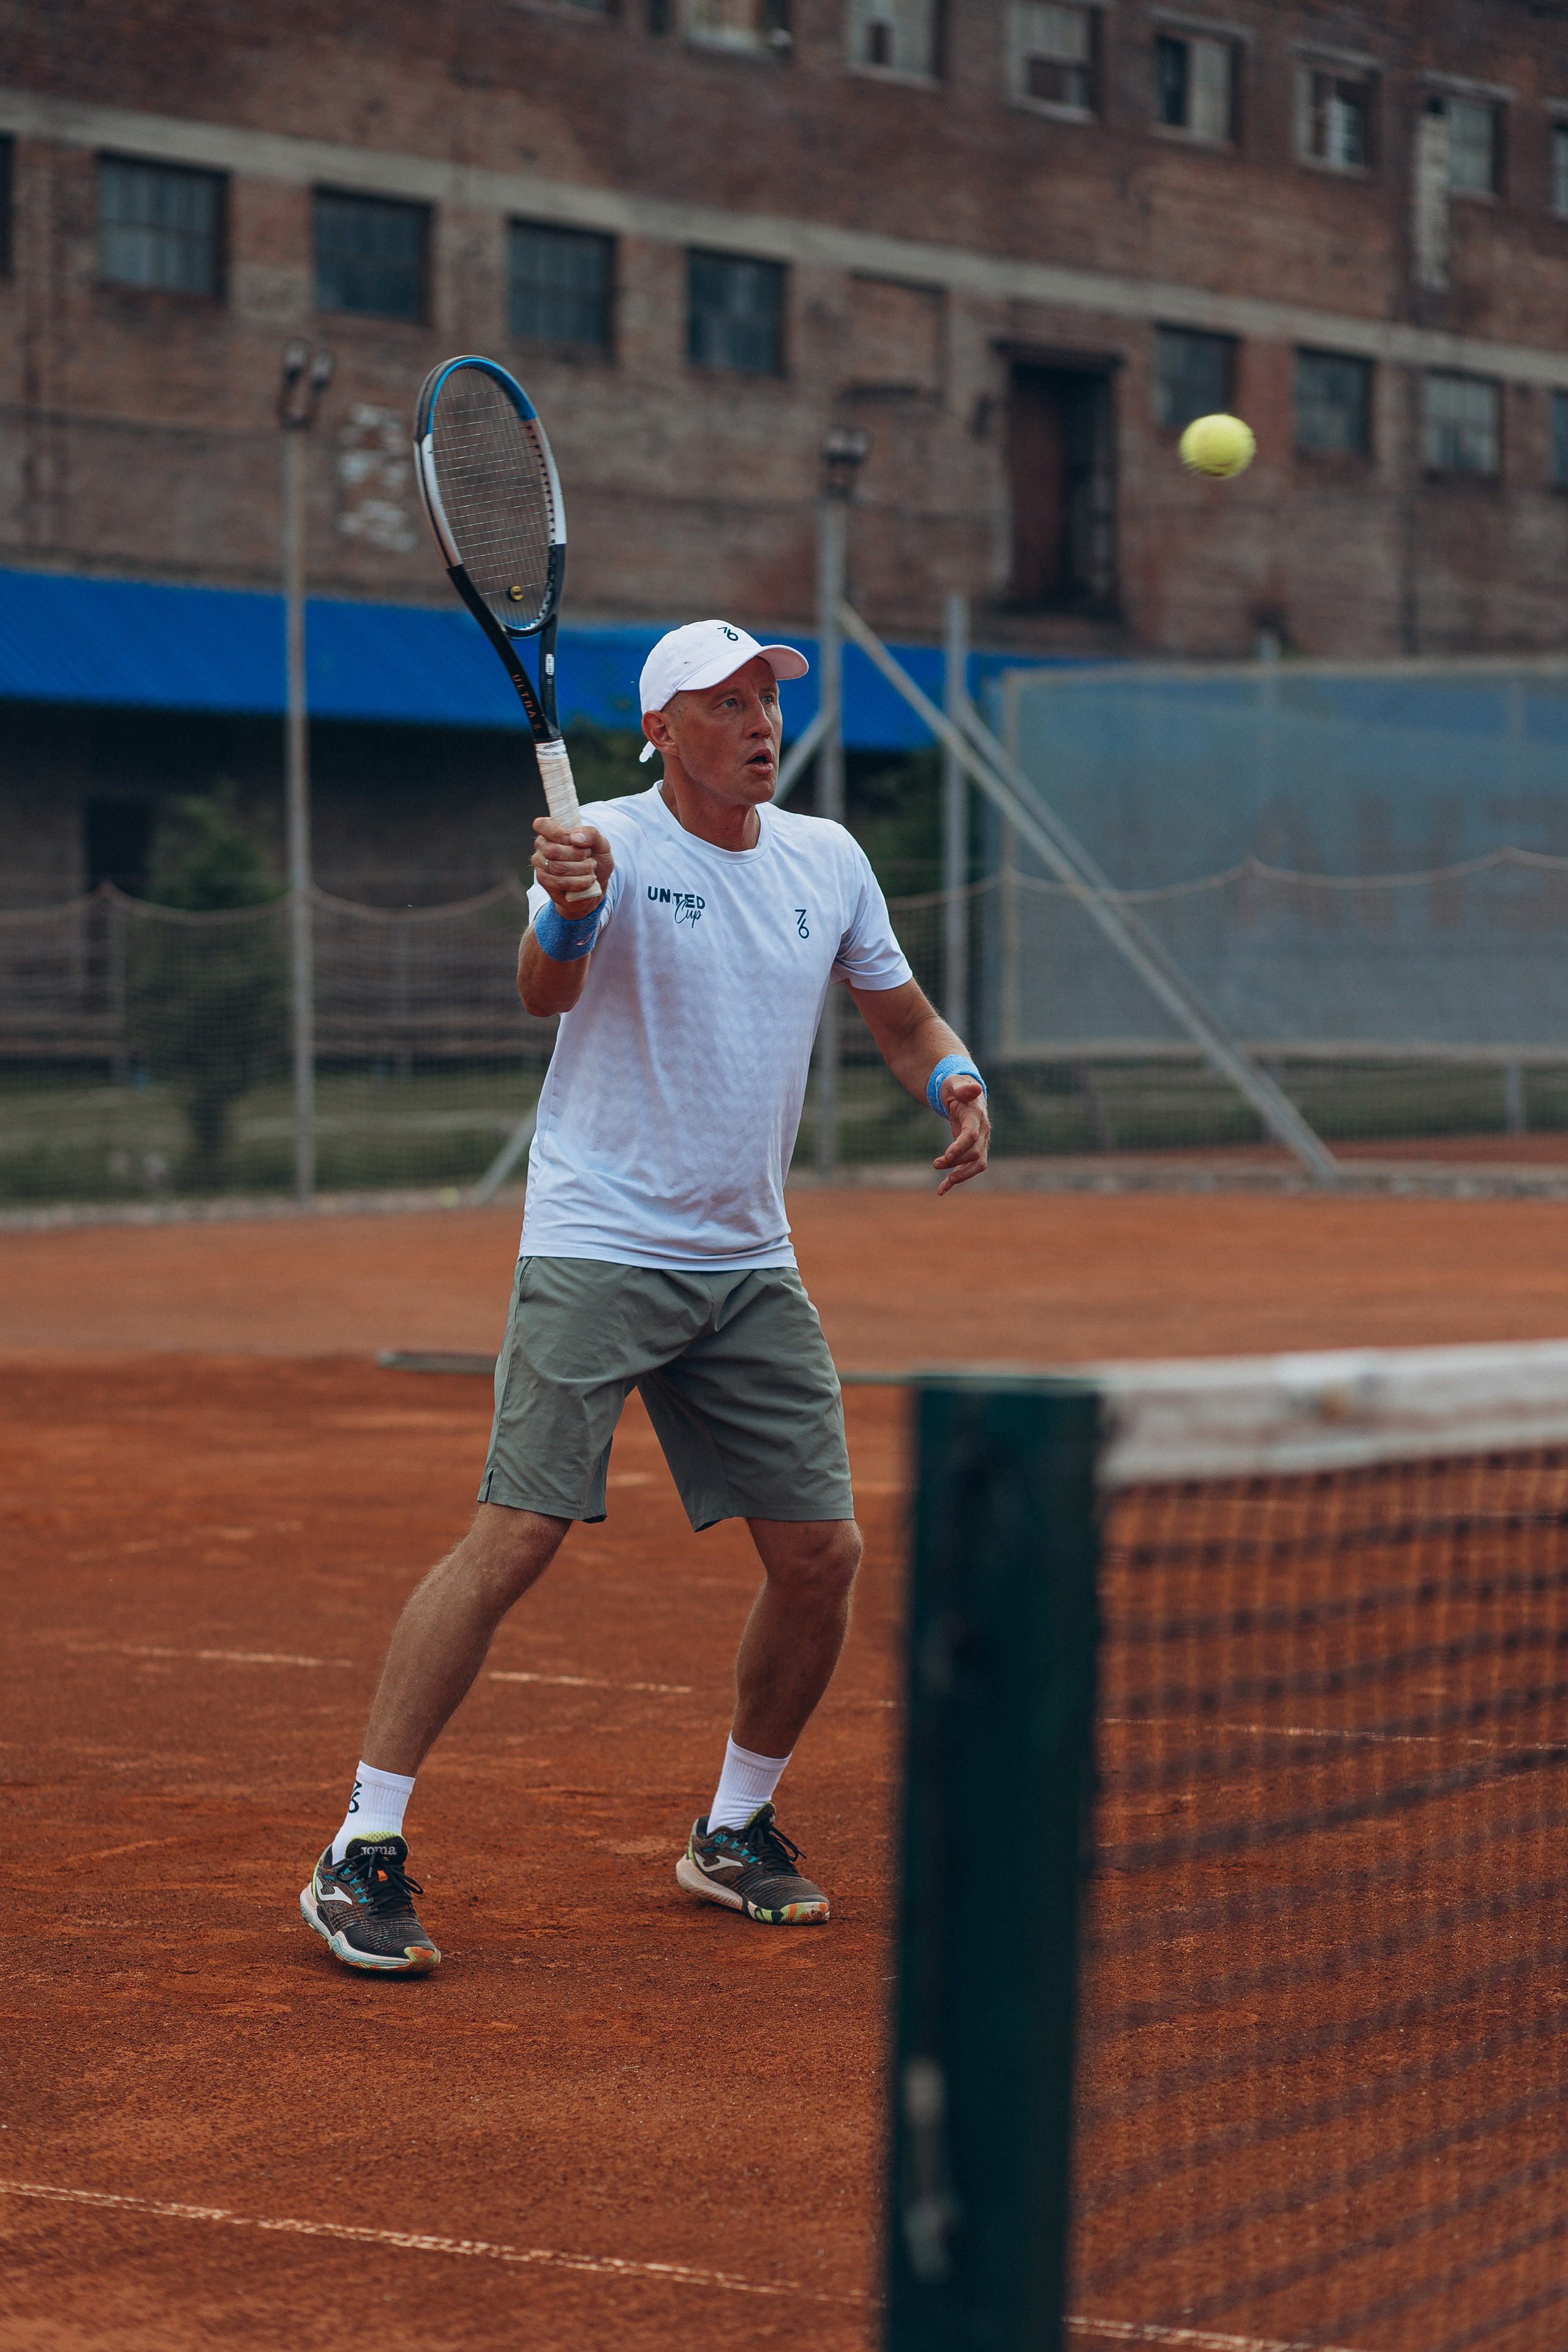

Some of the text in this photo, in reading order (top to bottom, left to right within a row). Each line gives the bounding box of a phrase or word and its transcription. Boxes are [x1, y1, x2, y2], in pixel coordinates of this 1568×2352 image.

[512, 674, 537, 718] ULTRA
[647, 886, 706, 910] UNTED
[674, 899, 703, 929] Cup
